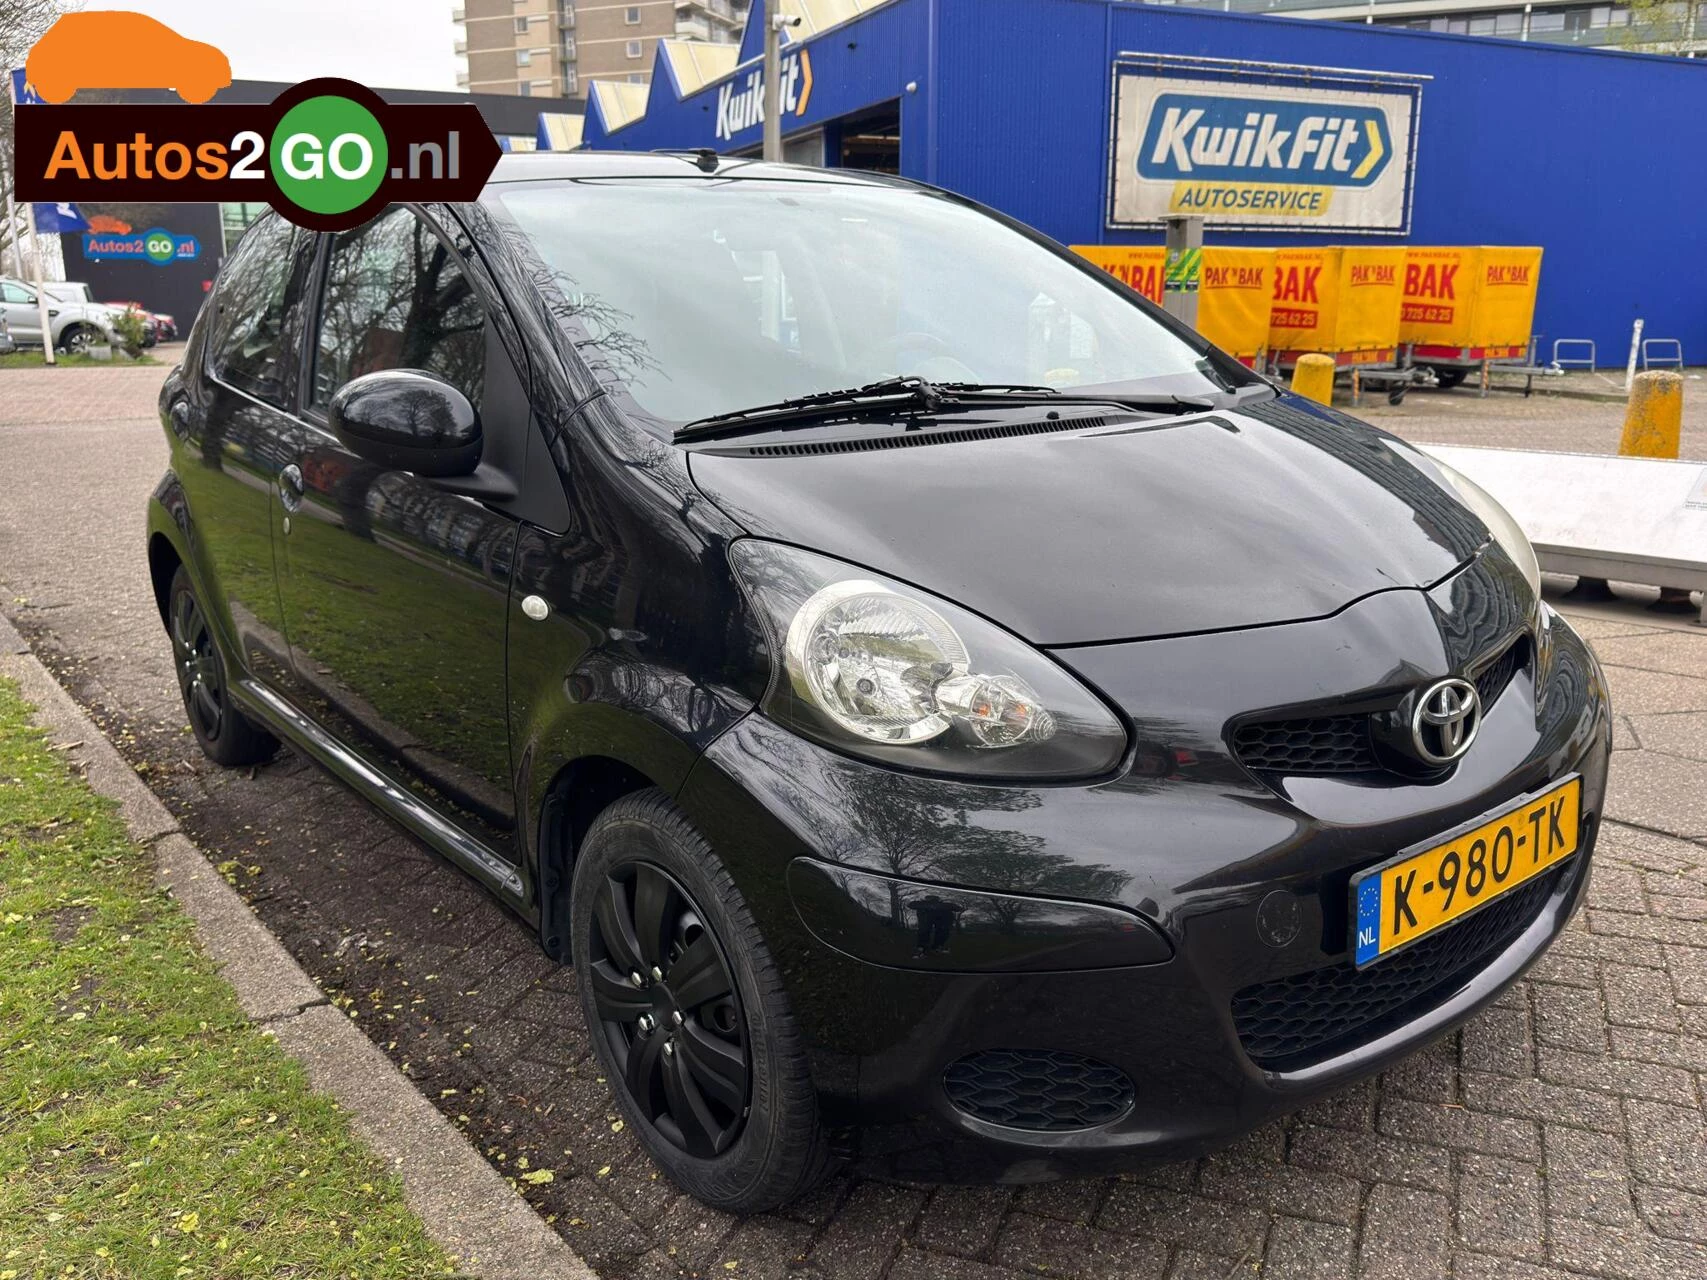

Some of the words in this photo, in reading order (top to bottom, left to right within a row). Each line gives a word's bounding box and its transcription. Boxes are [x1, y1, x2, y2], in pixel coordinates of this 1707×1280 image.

[1179, 188, 1322, 210] AUTOSERVICE
[1205, 266, 1229, 285] PAK
[1238, 267, 1263, 286] BAK
[1352, 265, 1369, 282] PAK
[1376, 265, 1395, 282] BAK
[1404, 264, 1459, 300] BAK
[1487, 265, 1505, 282] PAK
[1511, 266, 1531, 282] BAK
[1439, 308, 1452, 321] 25
[1393, 796, 1565, 935] K-980-TK
[1359, 926, 1376, 949] NL
